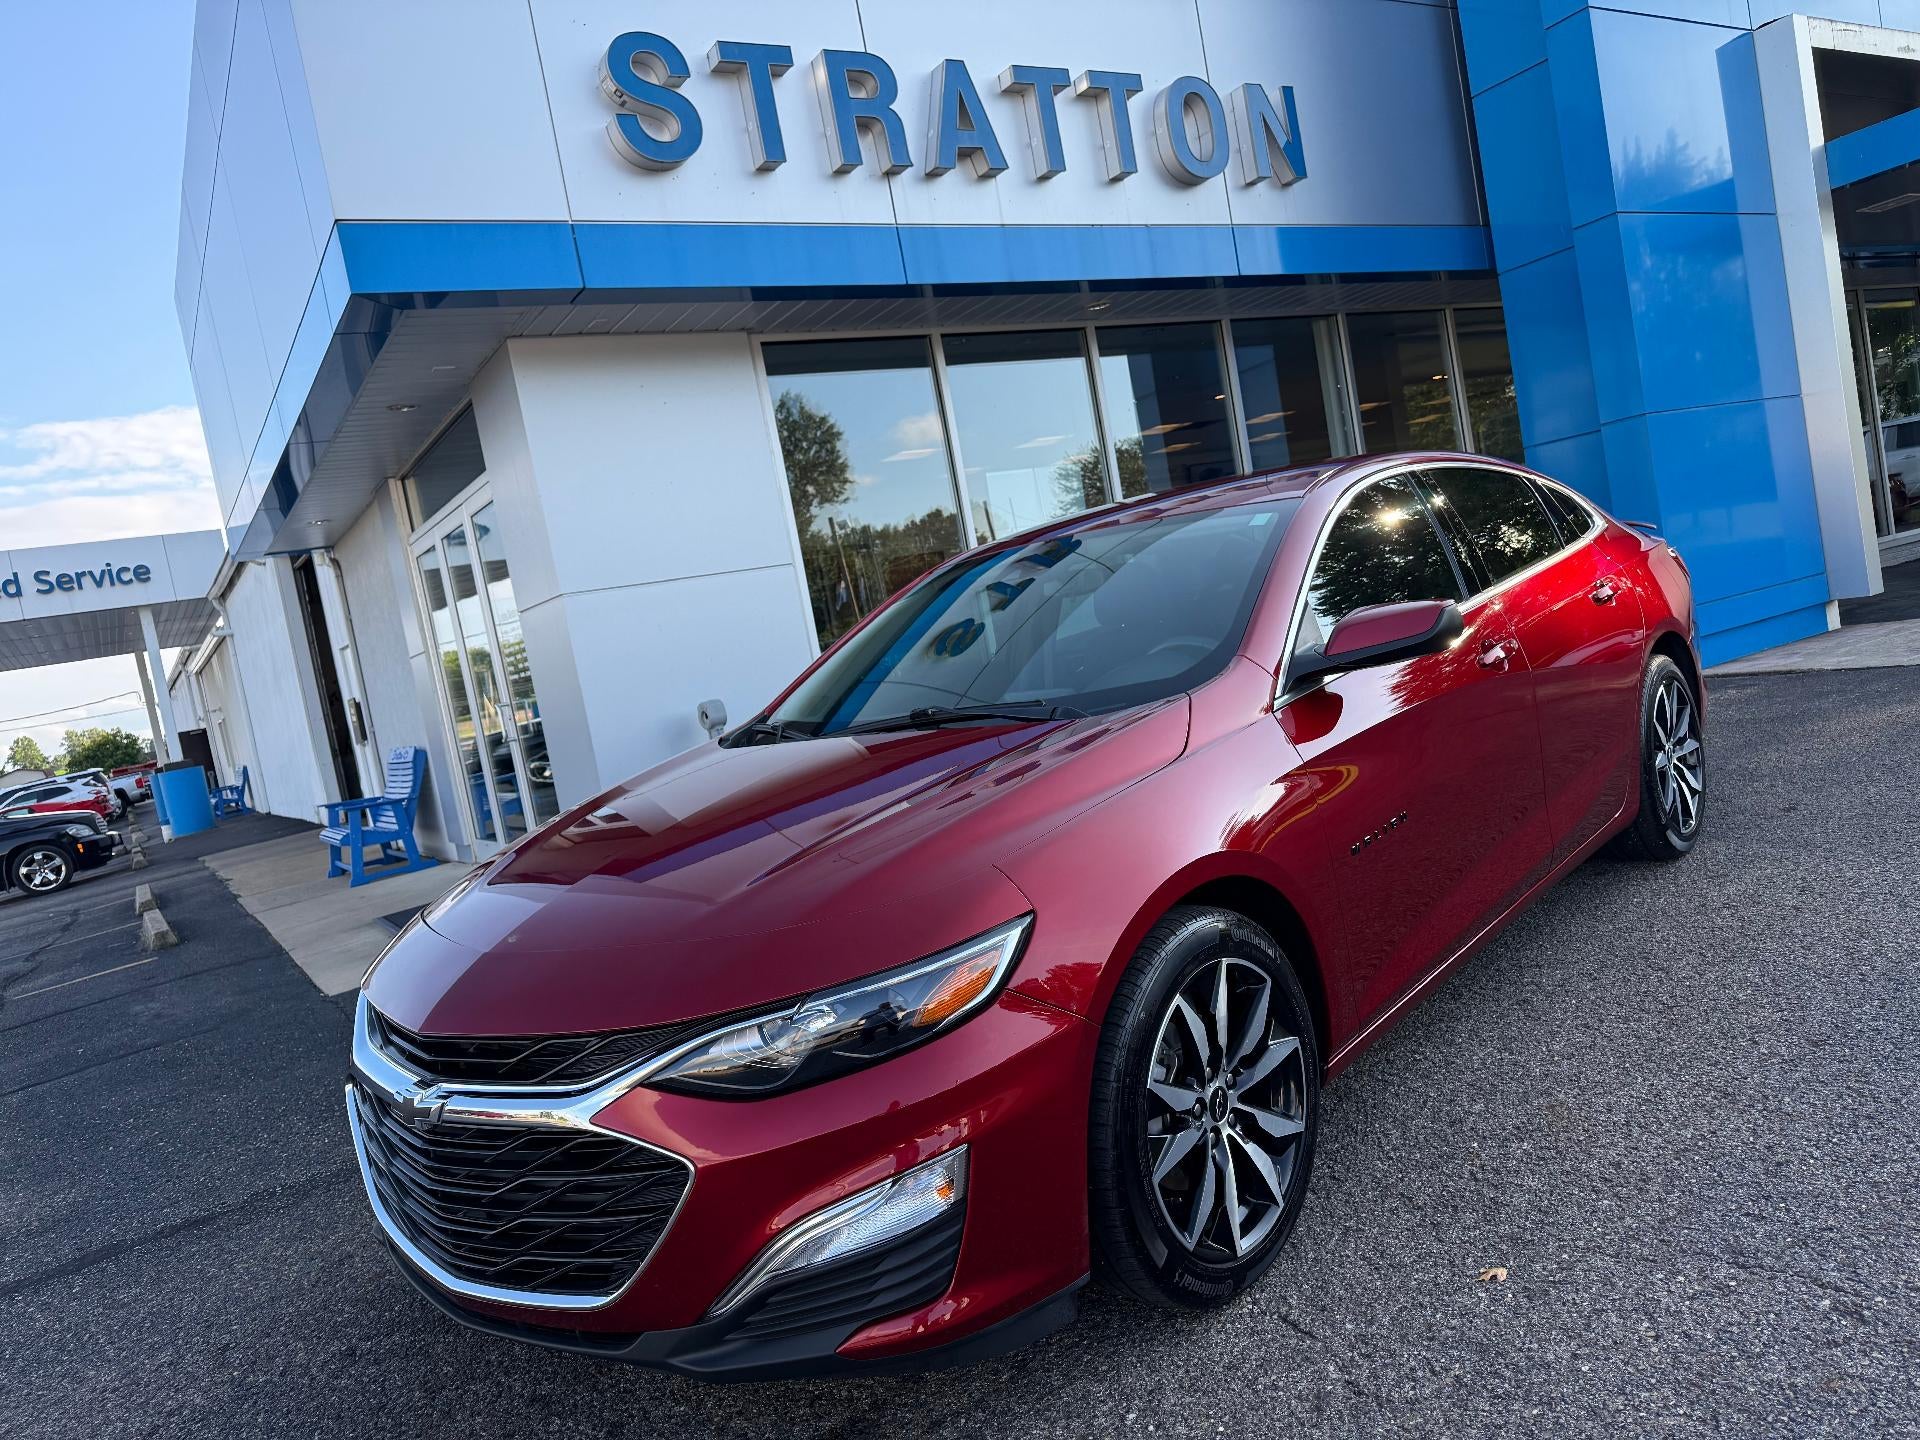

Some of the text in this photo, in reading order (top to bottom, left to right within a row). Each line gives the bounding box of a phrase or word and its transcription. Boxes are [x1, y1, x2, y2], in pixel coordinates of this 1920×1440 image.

[600, 31, 1308, 187] STRATTON
[0, 562, 152, 598] d Service
